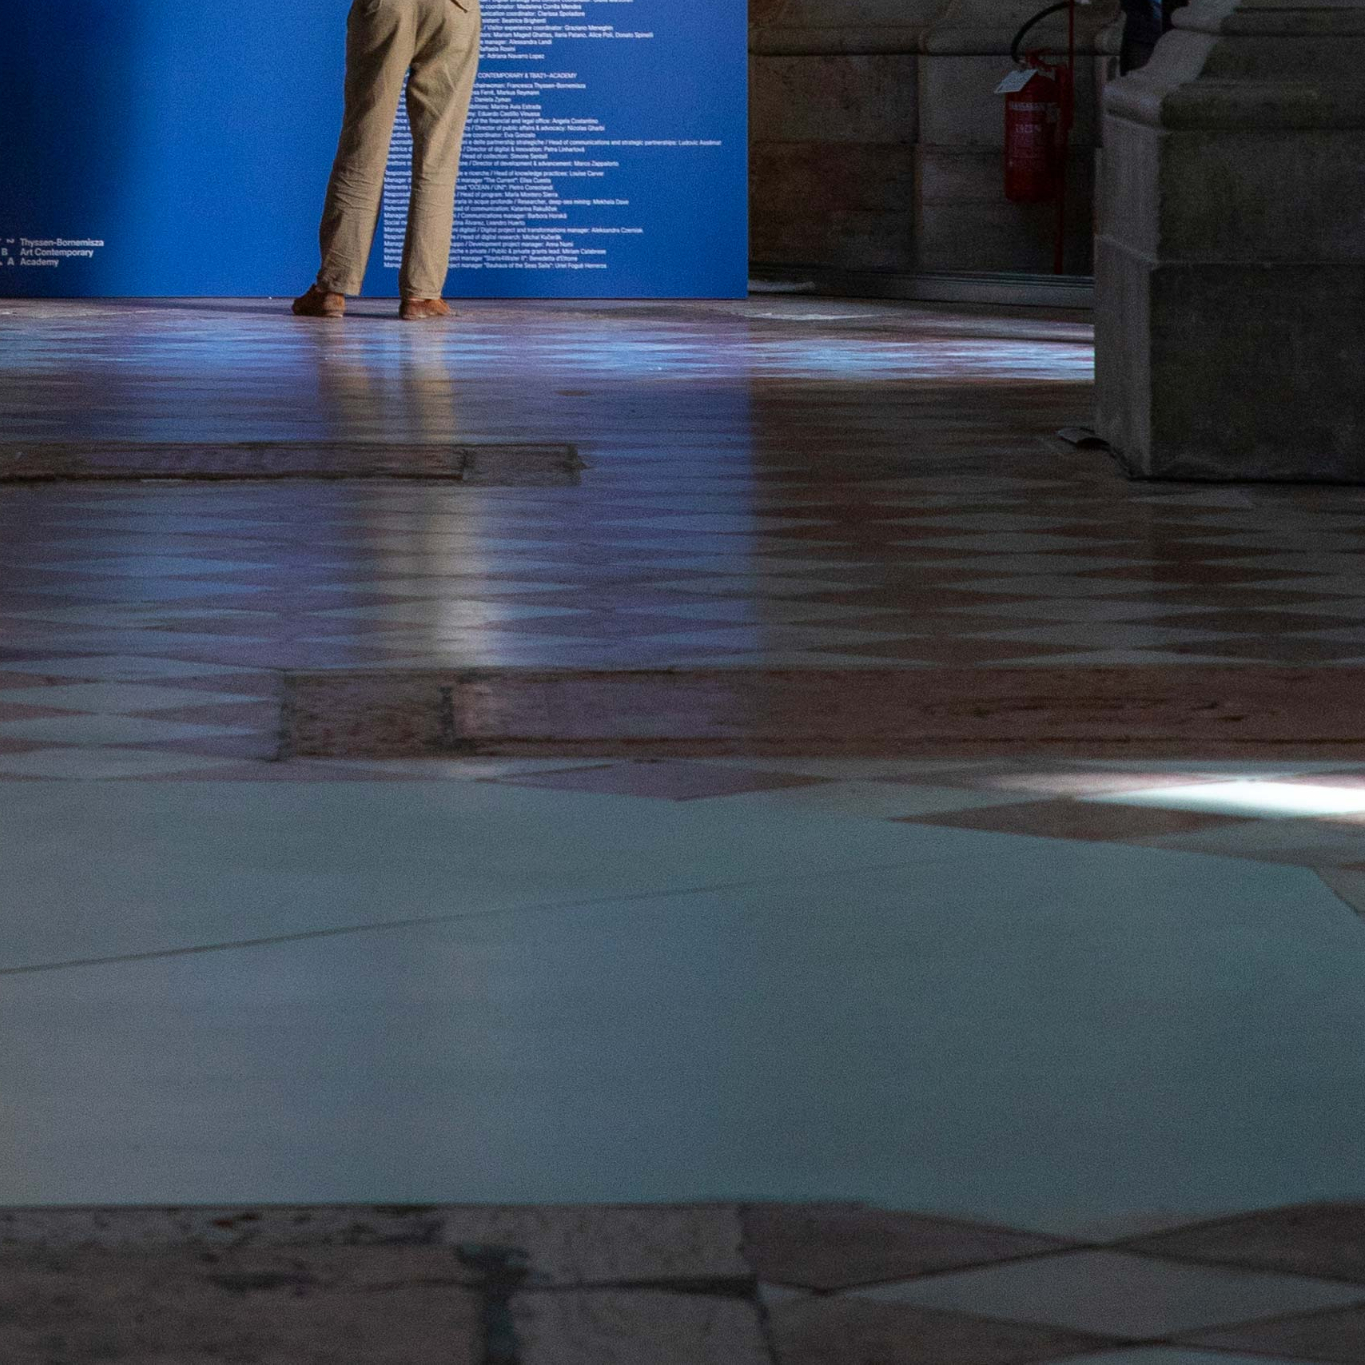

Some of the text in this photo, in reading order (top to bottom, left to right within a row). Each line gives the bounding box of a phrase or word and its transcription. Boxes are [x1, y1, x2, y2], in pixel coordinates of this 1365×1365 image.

[20, 238, 105, 247] Thyssen-Bornemisza
[20, 248, 94, 258] Art Contemporary
[20, 257, 59, 268] Academy
